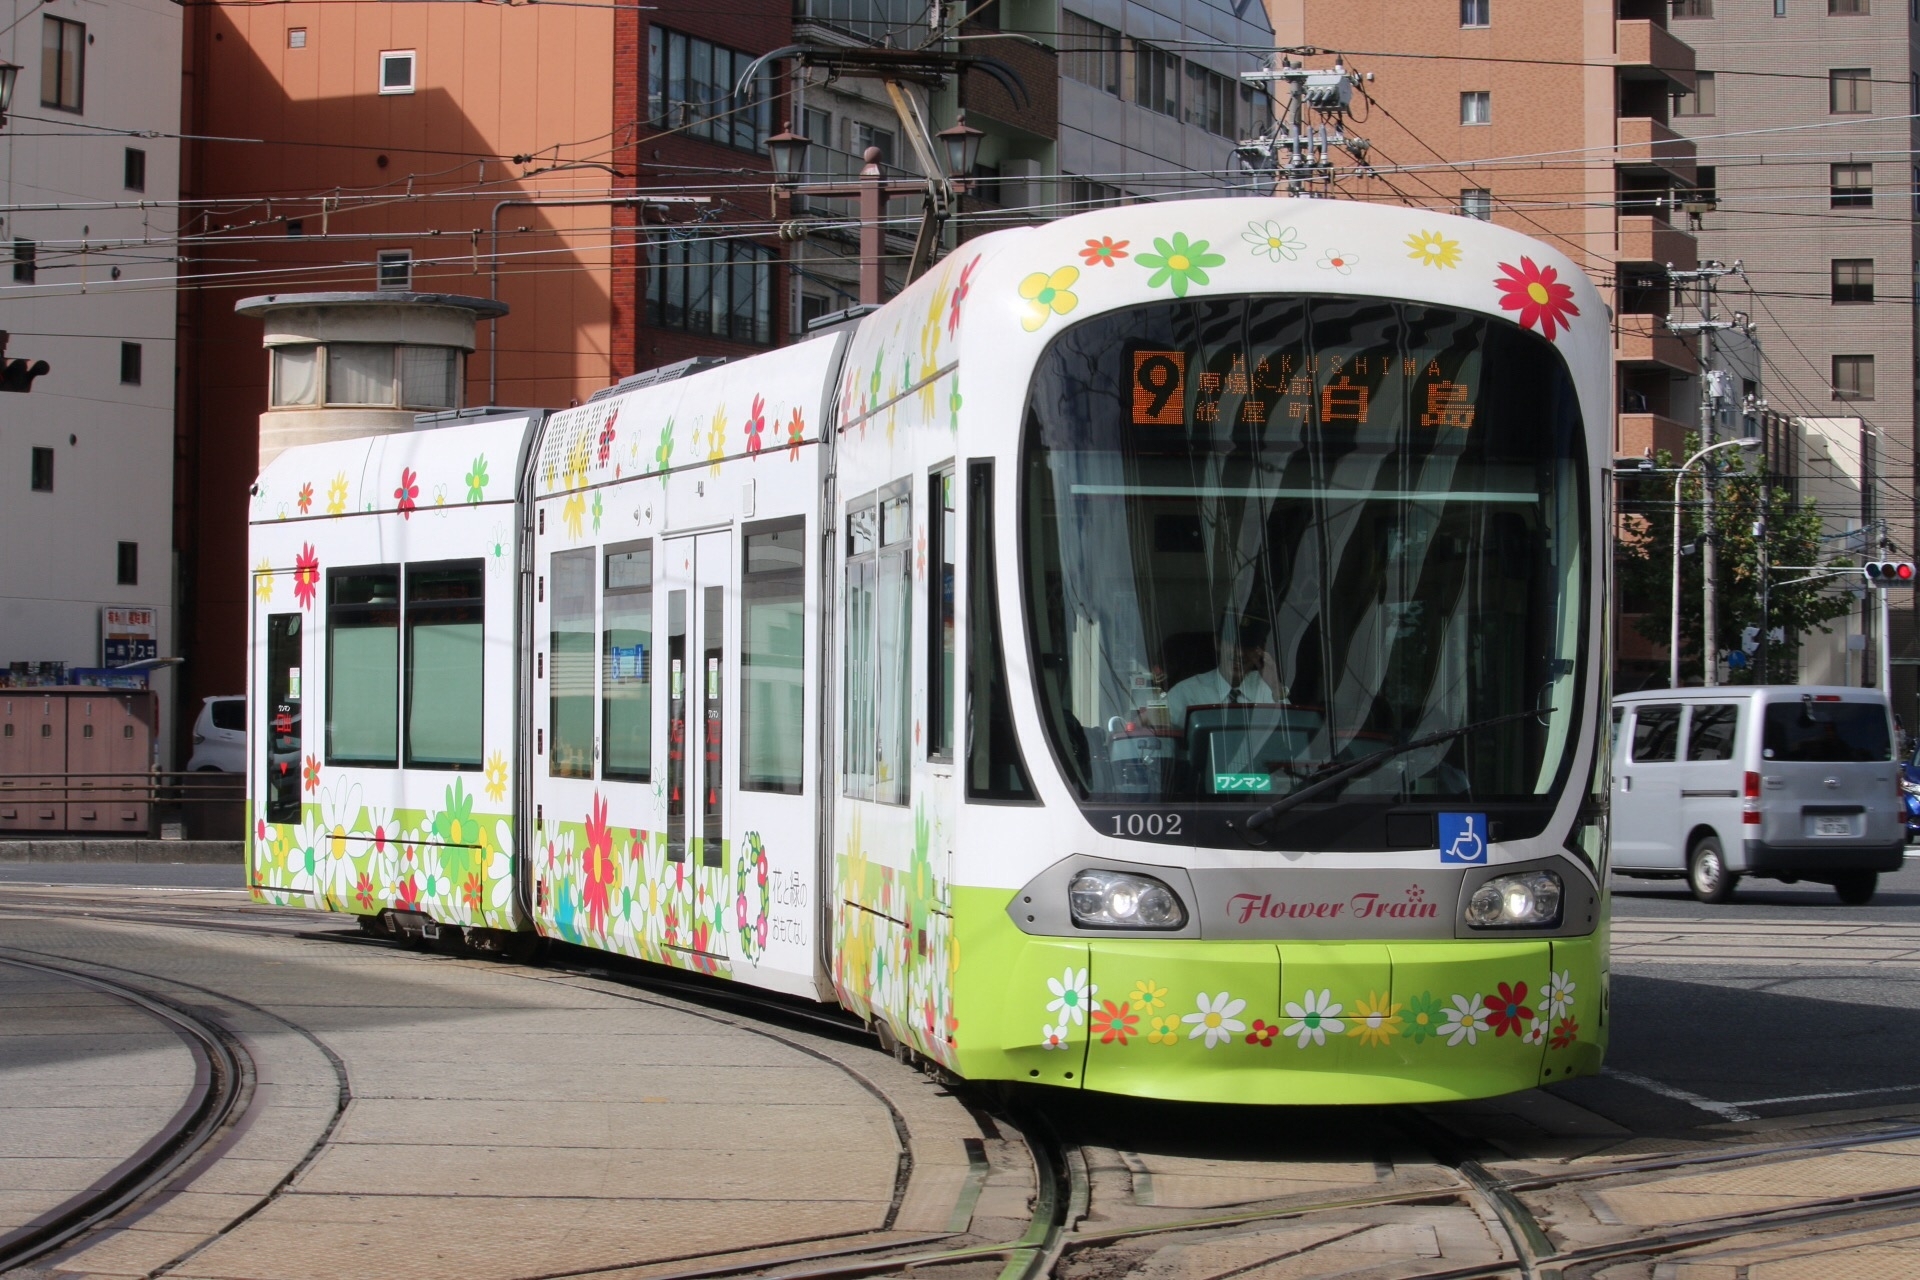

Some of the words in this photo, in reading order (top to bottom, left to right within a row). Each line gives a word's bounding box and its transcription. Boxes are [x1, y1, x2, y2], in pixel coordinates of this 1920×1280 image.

[1232, 353, 1441, 376] HAKUSHIMA
[1136, 353, 1181, 419] 9
[1321, 376, 1475, 428] 白島
[1215, 775, 1270, 790] ワンマン
[1110, 813, 1183, 836] 1002
[772, 867, 808, 908] 花と緑の
[1226, 892, 1345, 924] Flower
[1350, 885, 1441, 919] Train
[772, 916, 808, 946] おもてなし
